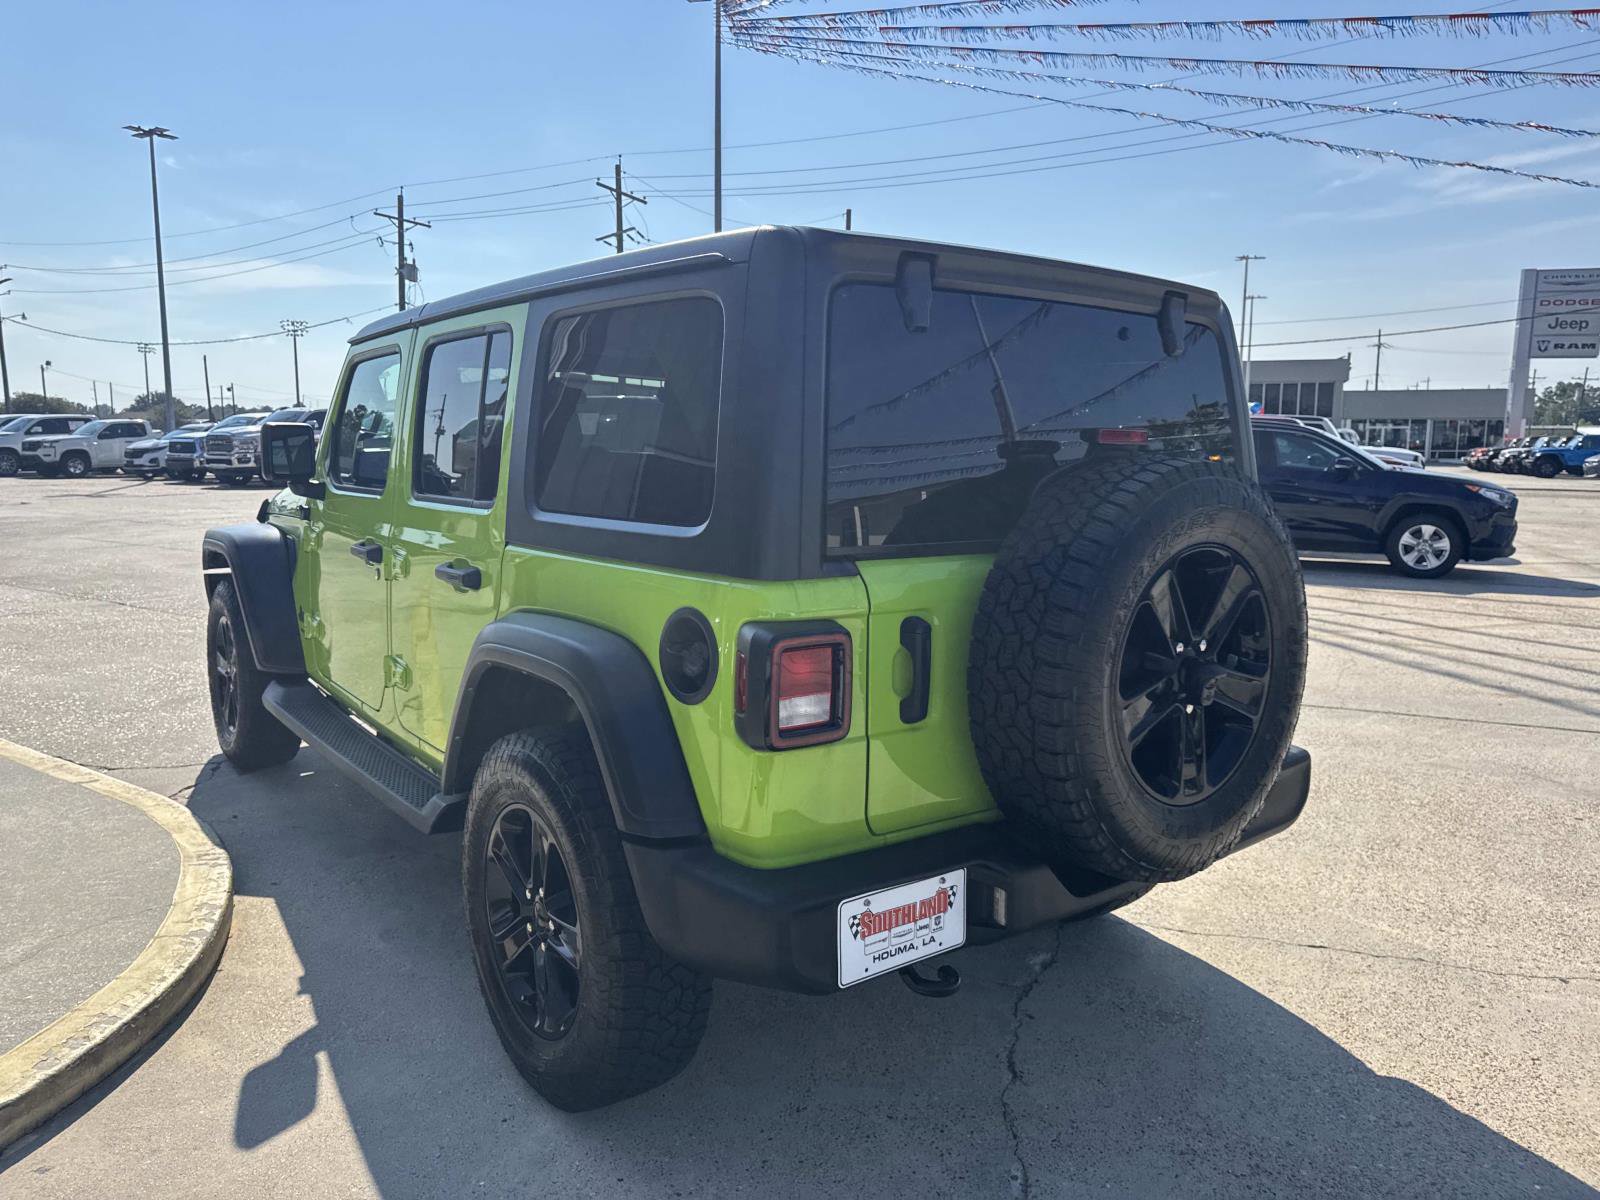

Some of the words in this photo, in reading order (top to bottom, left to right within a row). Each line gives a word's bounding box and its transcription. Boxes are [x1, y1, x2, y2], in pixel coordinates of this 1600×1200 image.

[1540, 298, 1600, 307] DODGE
[1547, 317, 1590, 332] Jeep
[860, 887, 949, 940] SOUTHLAND
[872, 943, 919, 963] HOUMA,
[922, 935, 936, 946] LA
